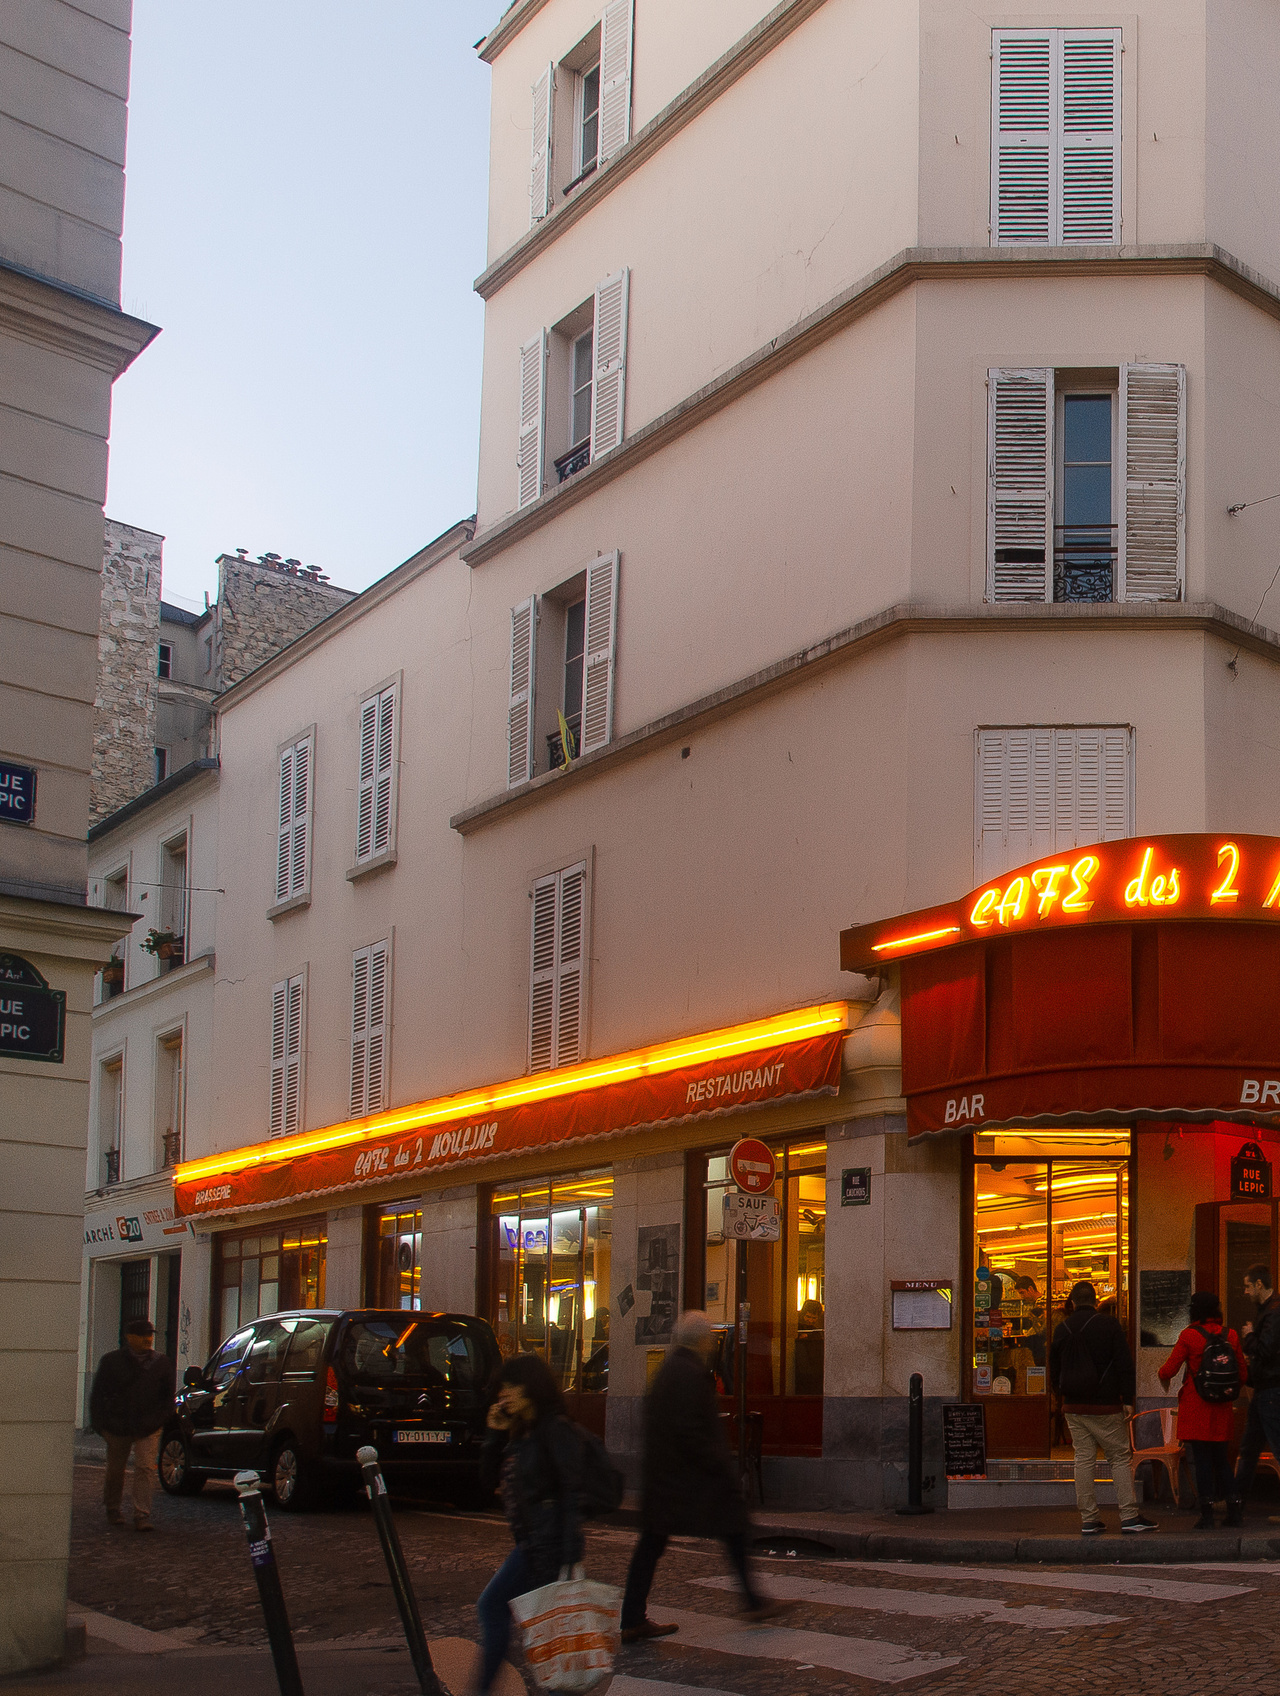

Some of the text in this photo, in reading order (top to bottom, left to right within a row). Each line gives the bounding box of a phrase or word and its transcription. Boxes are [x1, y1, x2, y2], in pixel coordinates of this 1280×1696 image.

[1124, 847, 1181, 908] des
[1210, 842, 1240, 906] 2
[686, 1063, 784, 1103] RESTAURANT
[944, 1094, 984, 1123] BAR
[394, 1144, 410, 1167] des
[414, 1137, 423, 1164] 2
[428, 1122, 498, 1161] MOULINS
[1243, 1168, 1260, 1180] RUE
[195, 1185, 231, 1205] BRASSERIE
[1240, 1181, 1264, 1193] LEPIC
[738, 1197, 767, 1210] SAUF
[84, 1224, 115, 1244] ARCHÉ
[117, 1219, 140, 1237] G20
[399, 1432, 446, 1441] DY-011-YJ
